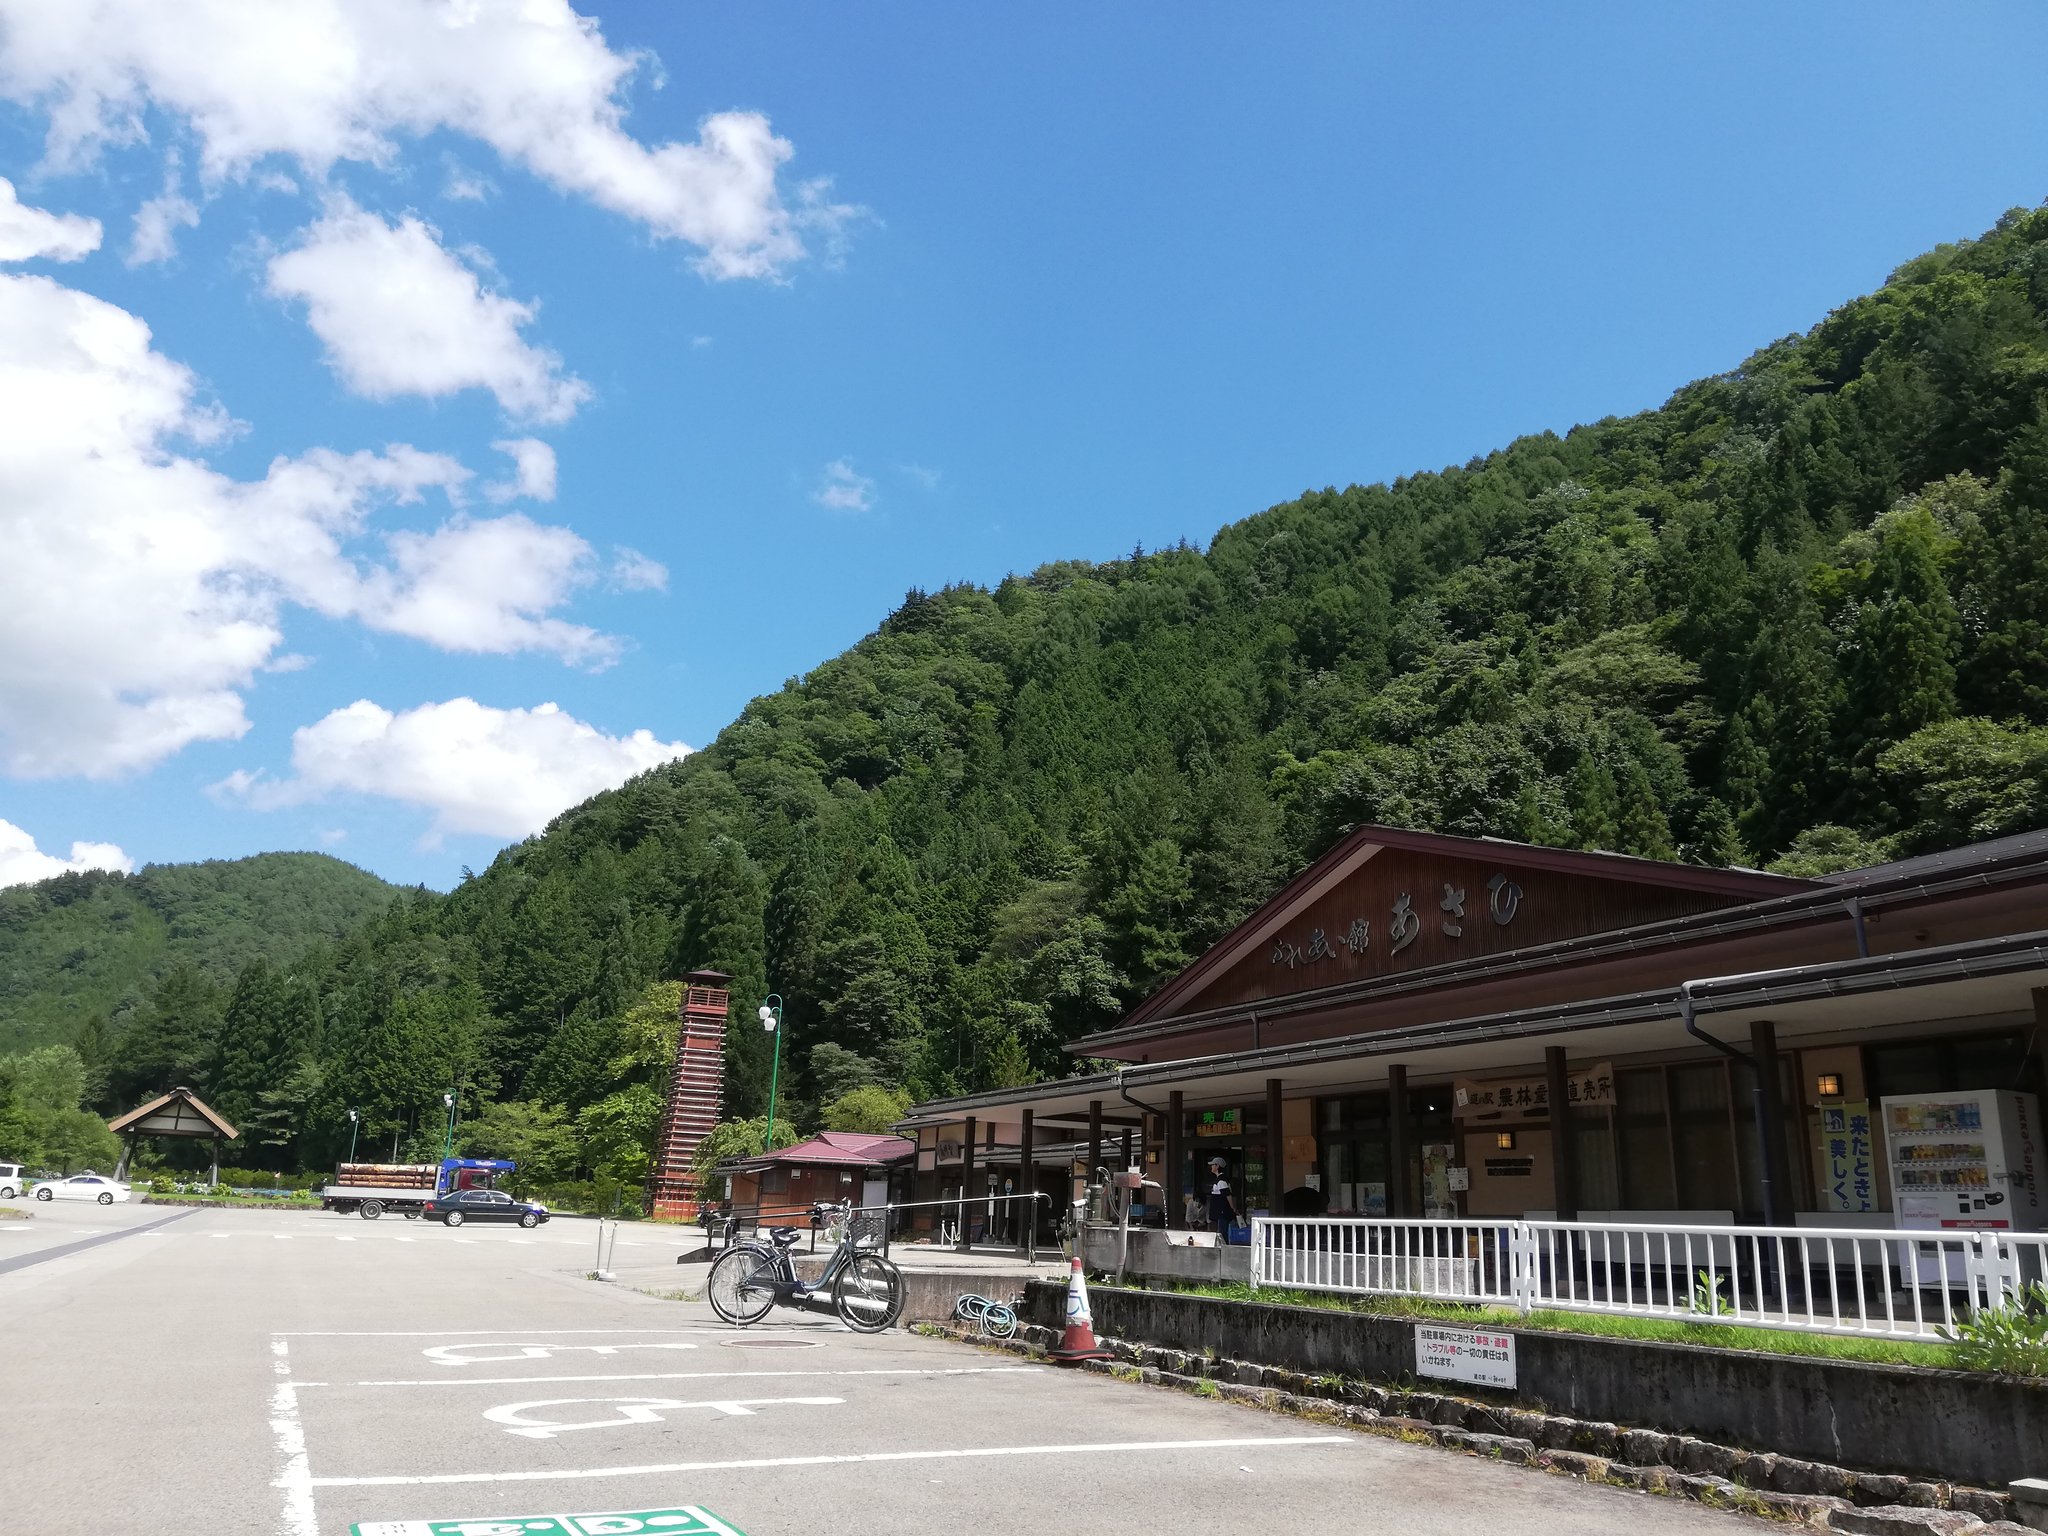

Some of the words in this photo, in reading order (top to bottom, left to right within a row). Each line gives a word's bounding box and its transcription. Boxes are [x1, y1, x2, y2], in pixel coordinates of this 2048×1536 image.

[1390, 872, 1524, 958] あさひ
[1202, 1109, 1235, 1124] 売店
[1421, 1355, 1455, 1368] いかねます。
